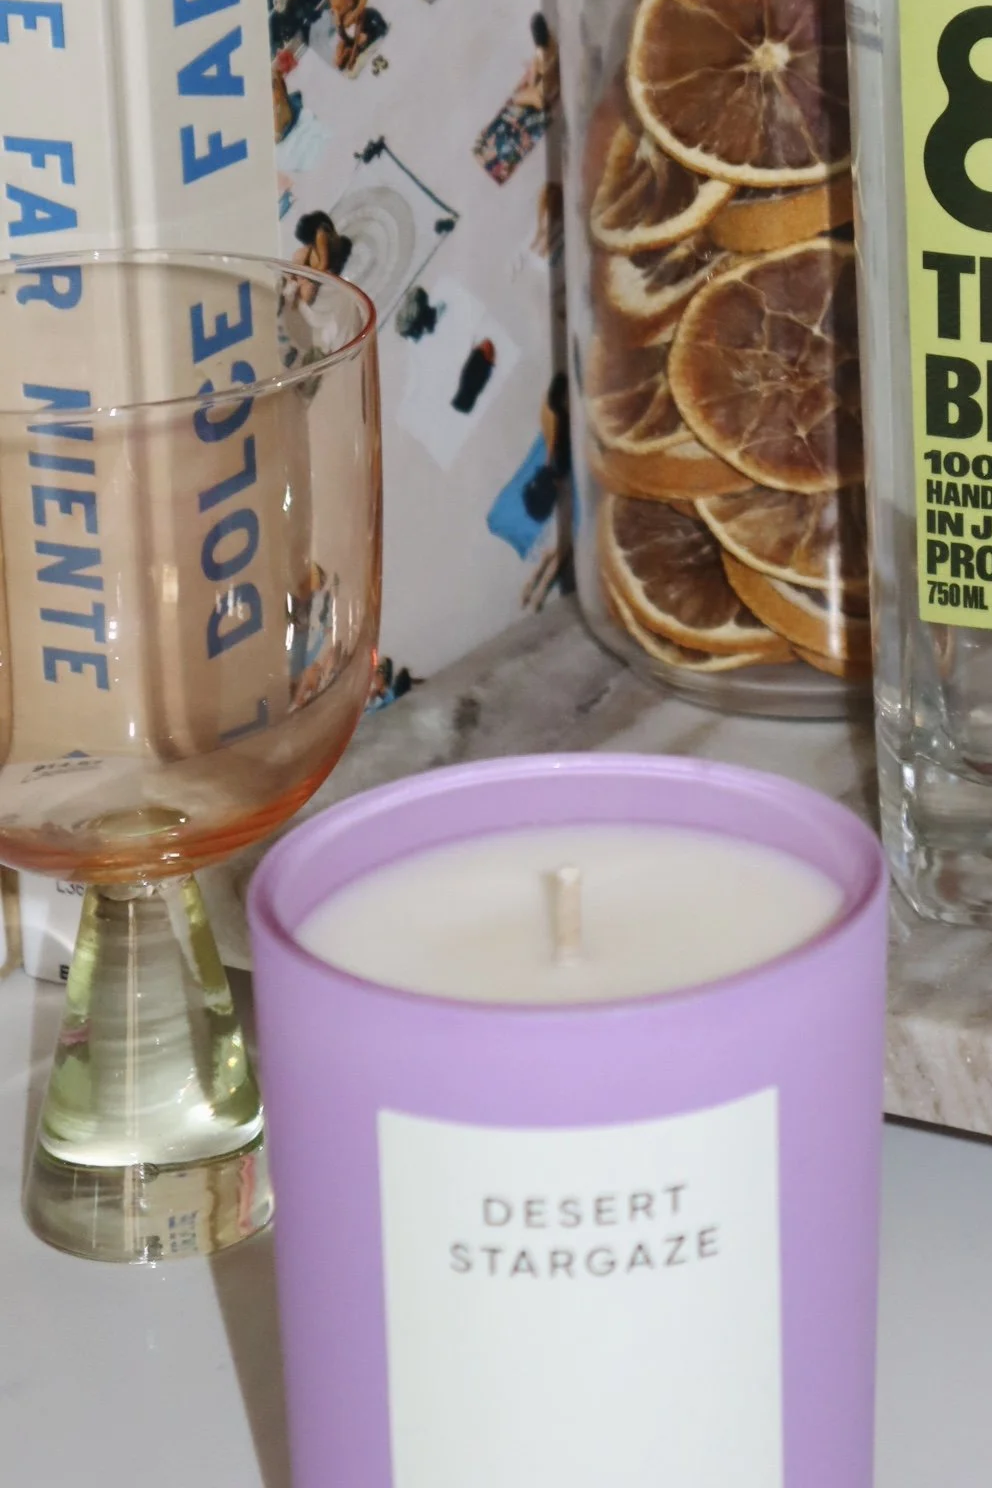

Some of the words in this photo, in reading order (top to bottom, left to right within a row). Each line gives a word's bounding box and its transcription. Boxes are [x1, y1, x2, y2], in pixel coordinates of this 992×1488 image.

[3, 135, 83, 309] FAR
[194, 280, 263, 659] DOLCE
[22, 382, 110, 691] NIENTE
[926, 509, 964, 537] IN
[927, 580, 961, 608] 750
[963, 584, 989, 610] ML
[482, 1181, 688, 1229] DESERT
[448, 1226, 721, 1279] STARGAZE
